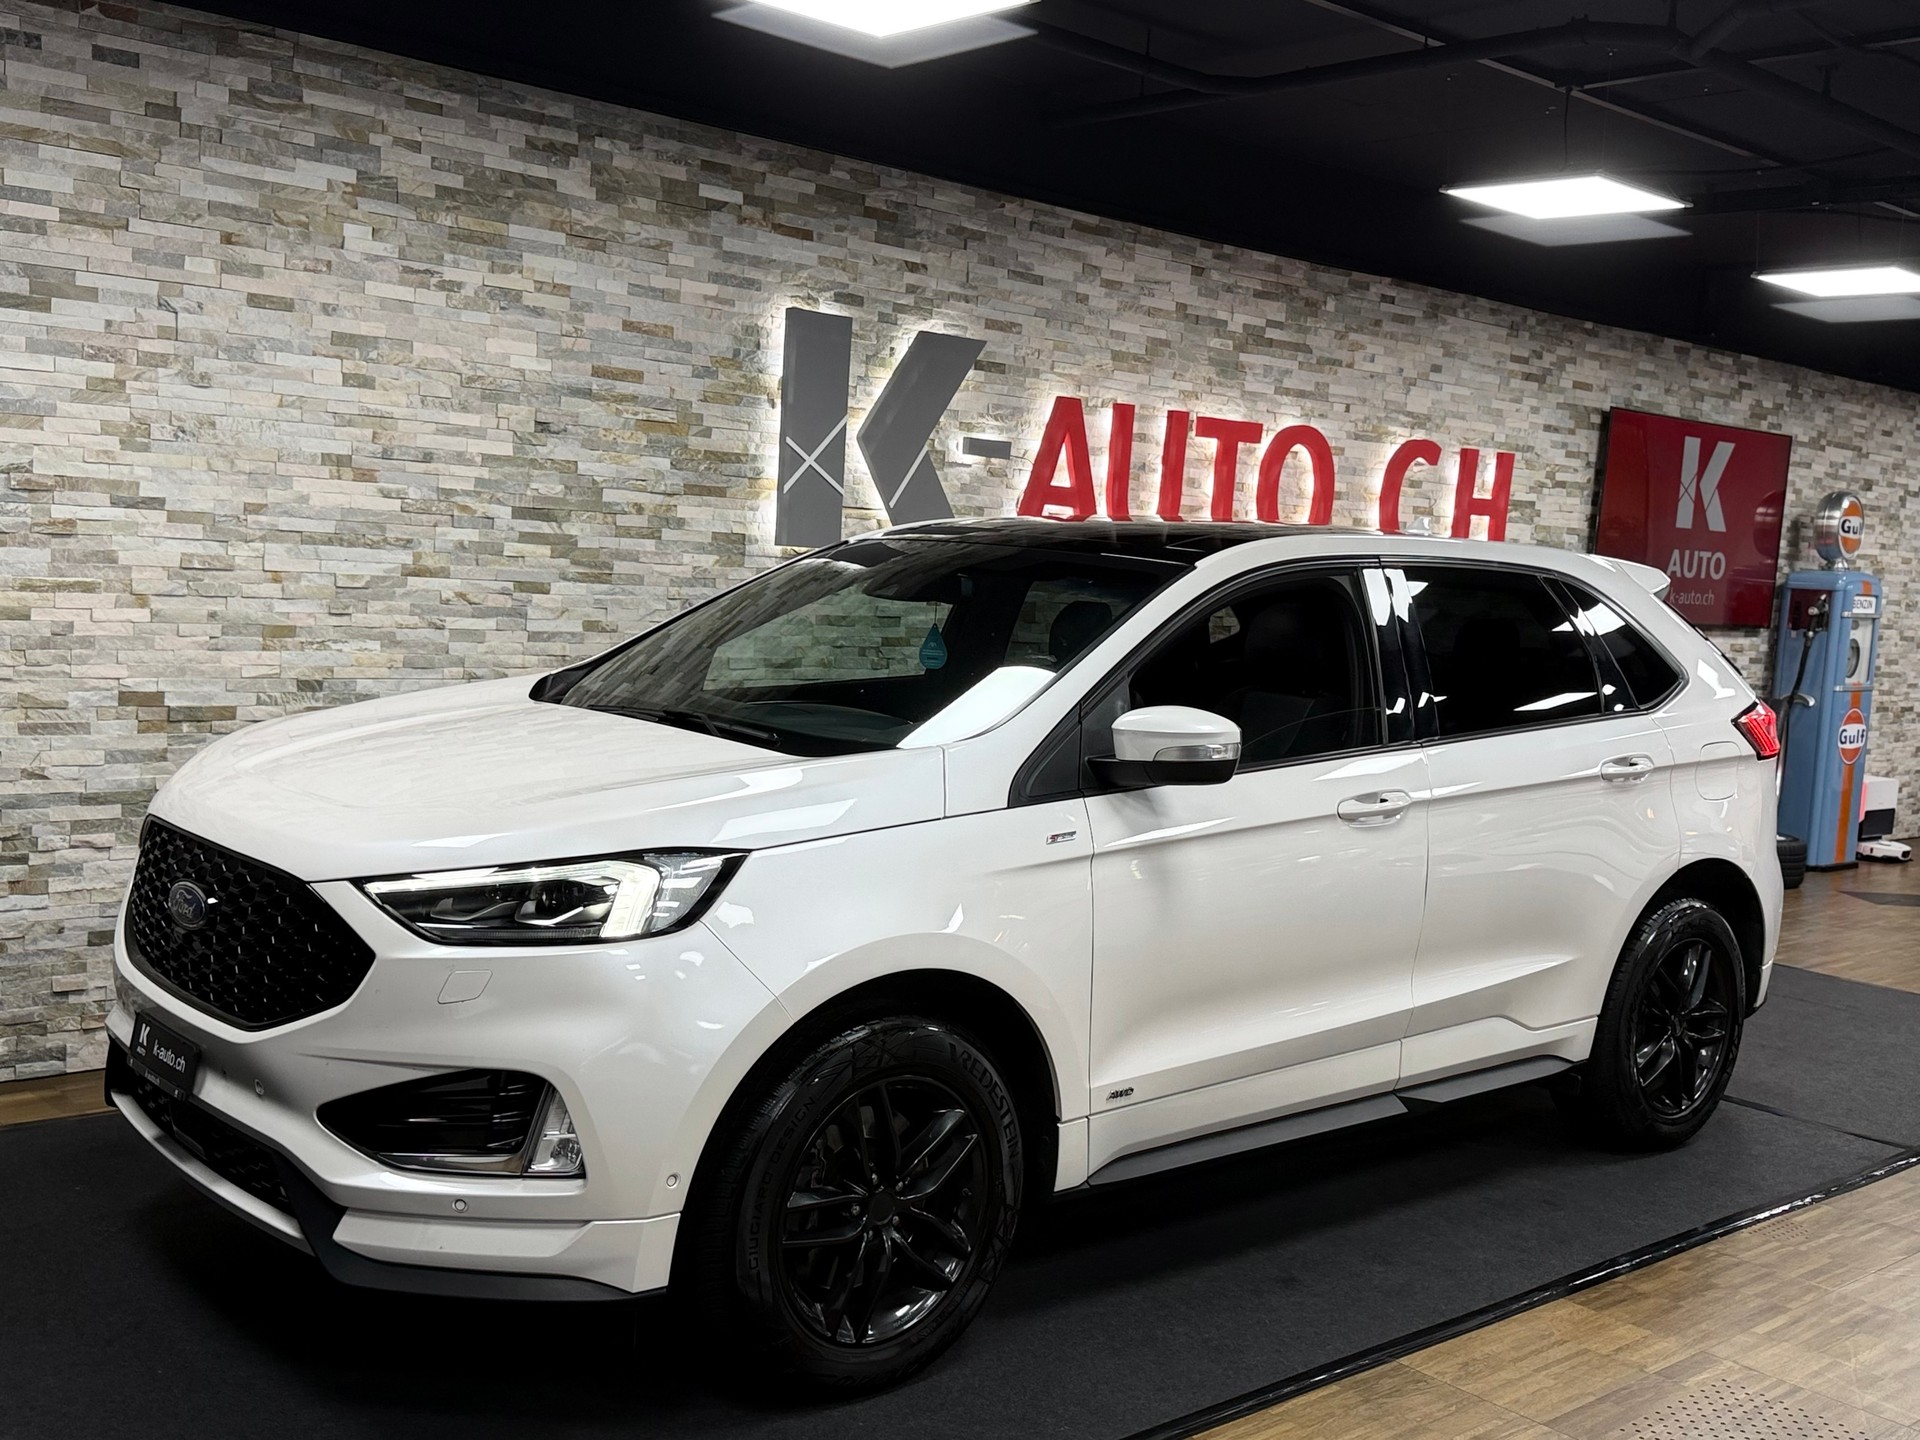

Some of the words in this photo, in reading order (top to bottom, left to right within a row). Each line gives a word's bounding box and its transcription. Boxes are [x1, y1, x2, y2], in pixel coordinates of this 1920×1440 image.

[1675, 436, 1735, 532] K
[1666, 549, 1726, 580] AUTO
[1669, 587, 1715, 606] k-auto.ch
[1839, 728, 1865, 745] Gulf
[138, 1023, 151, 1046] K
[152, 1039, 186, 1074] k-auto.ch
